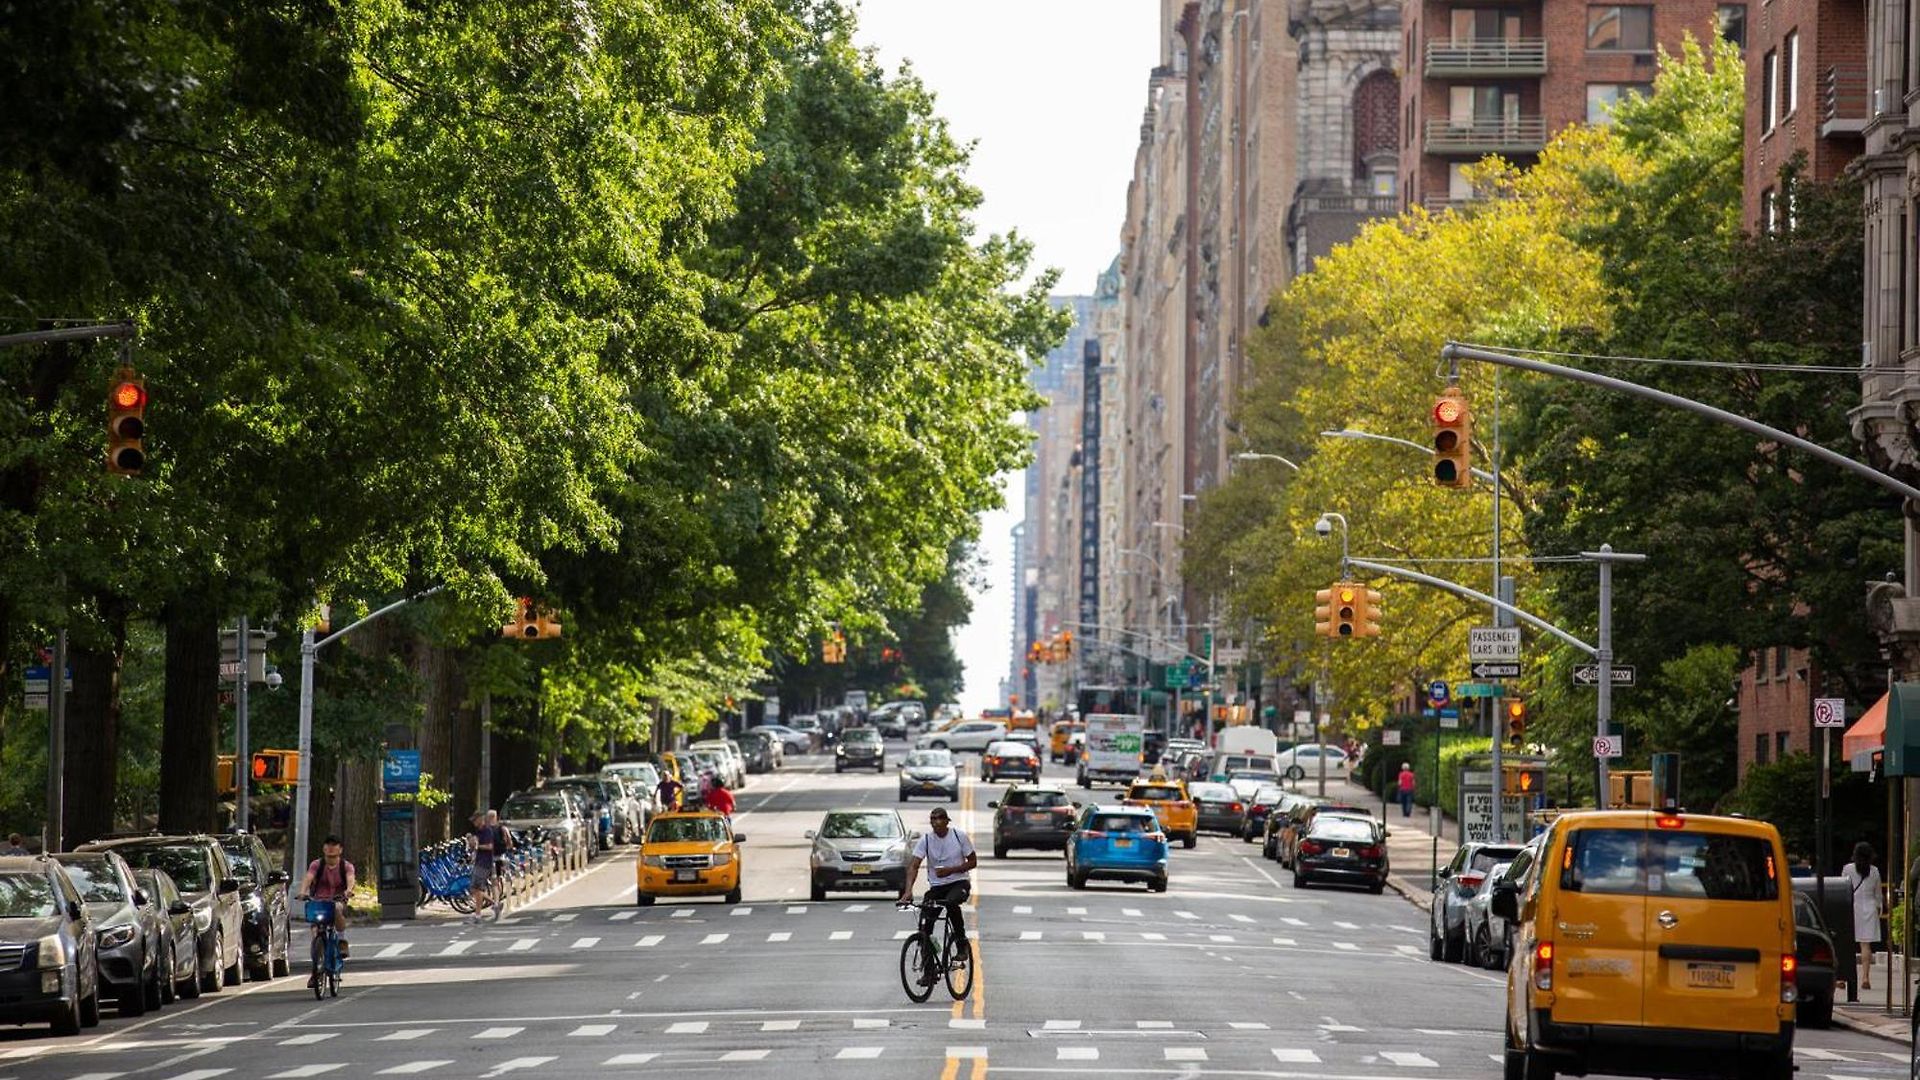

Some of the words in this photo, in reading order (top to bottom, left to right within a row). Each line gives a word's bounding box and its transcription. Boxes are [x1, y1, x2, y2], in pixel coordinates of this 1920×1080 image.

[1472, 631, 1516, 641] PASSENGER
[1472, 644, 1492, 654] CARS
[1497, 644, 1516, 655] ONLY
[1478, 666, 1491, 674] ONE
[1500, 666, 1515, 674] WAY
[1581, 670, 1598, 679] ONE
[1611, 670, 1628, 679] WAY
[1470, 831, 1488, 840] YOU
